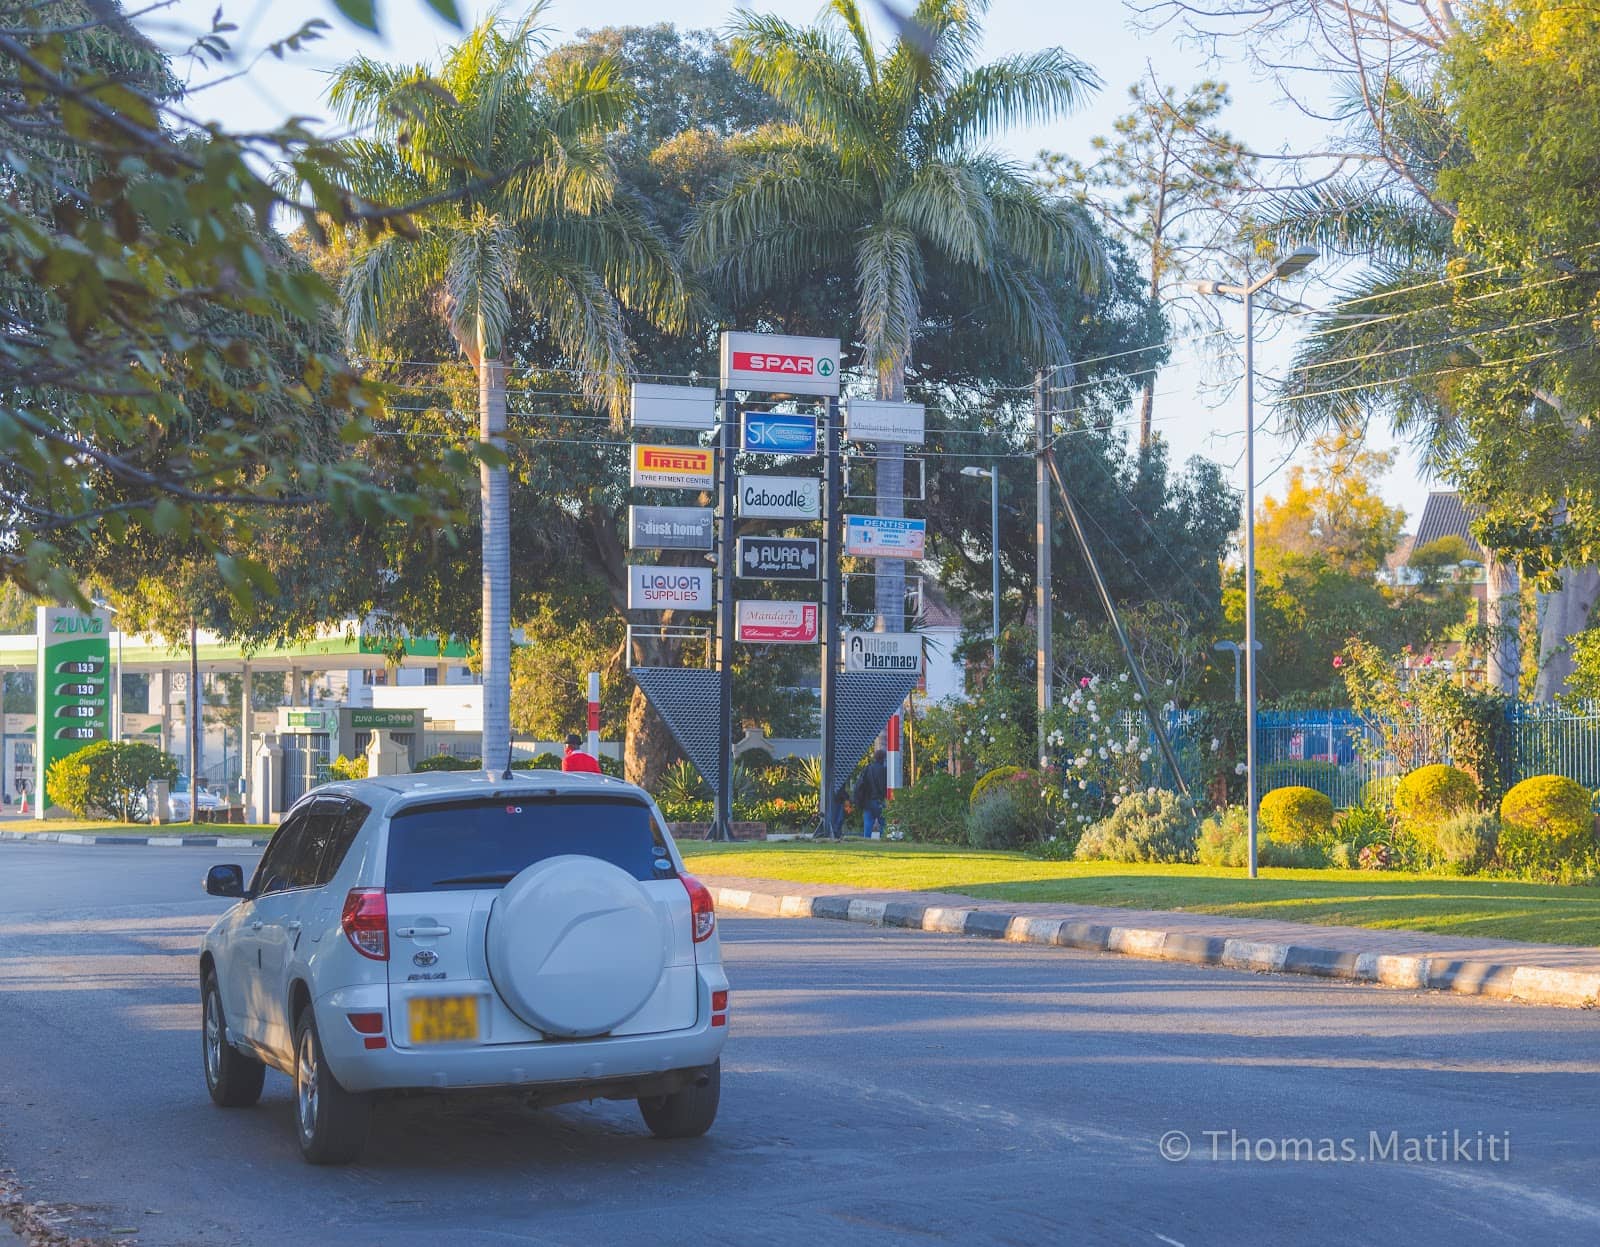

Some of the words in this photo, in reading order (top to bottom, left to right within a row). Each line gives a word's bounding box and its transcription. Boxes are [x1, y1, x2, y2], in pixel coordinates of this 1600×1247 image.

[750, 355, 812, 372] SPAR
[748, 421, 778, 445] SK
[644, 451, 706, 470] PIRELLI
[659, 475, 684, 483] FITMENT
[686, 477, 710, 485] CENTRE
[745, 487, 806, 507] Caboodle
[673, 522, 704, 536] home
[863, 519, 912, 529] DENTIST
[761, 546, 800, 562] AURA
[641, 575, 701, 590] LIQUOR
[645, 590, 698, 601] SUPPLIES
[746, 609, 798, 620] Mandarin
[864, 638, 898, 655] Village
[864, 653, 918, 670] Pharmacy
